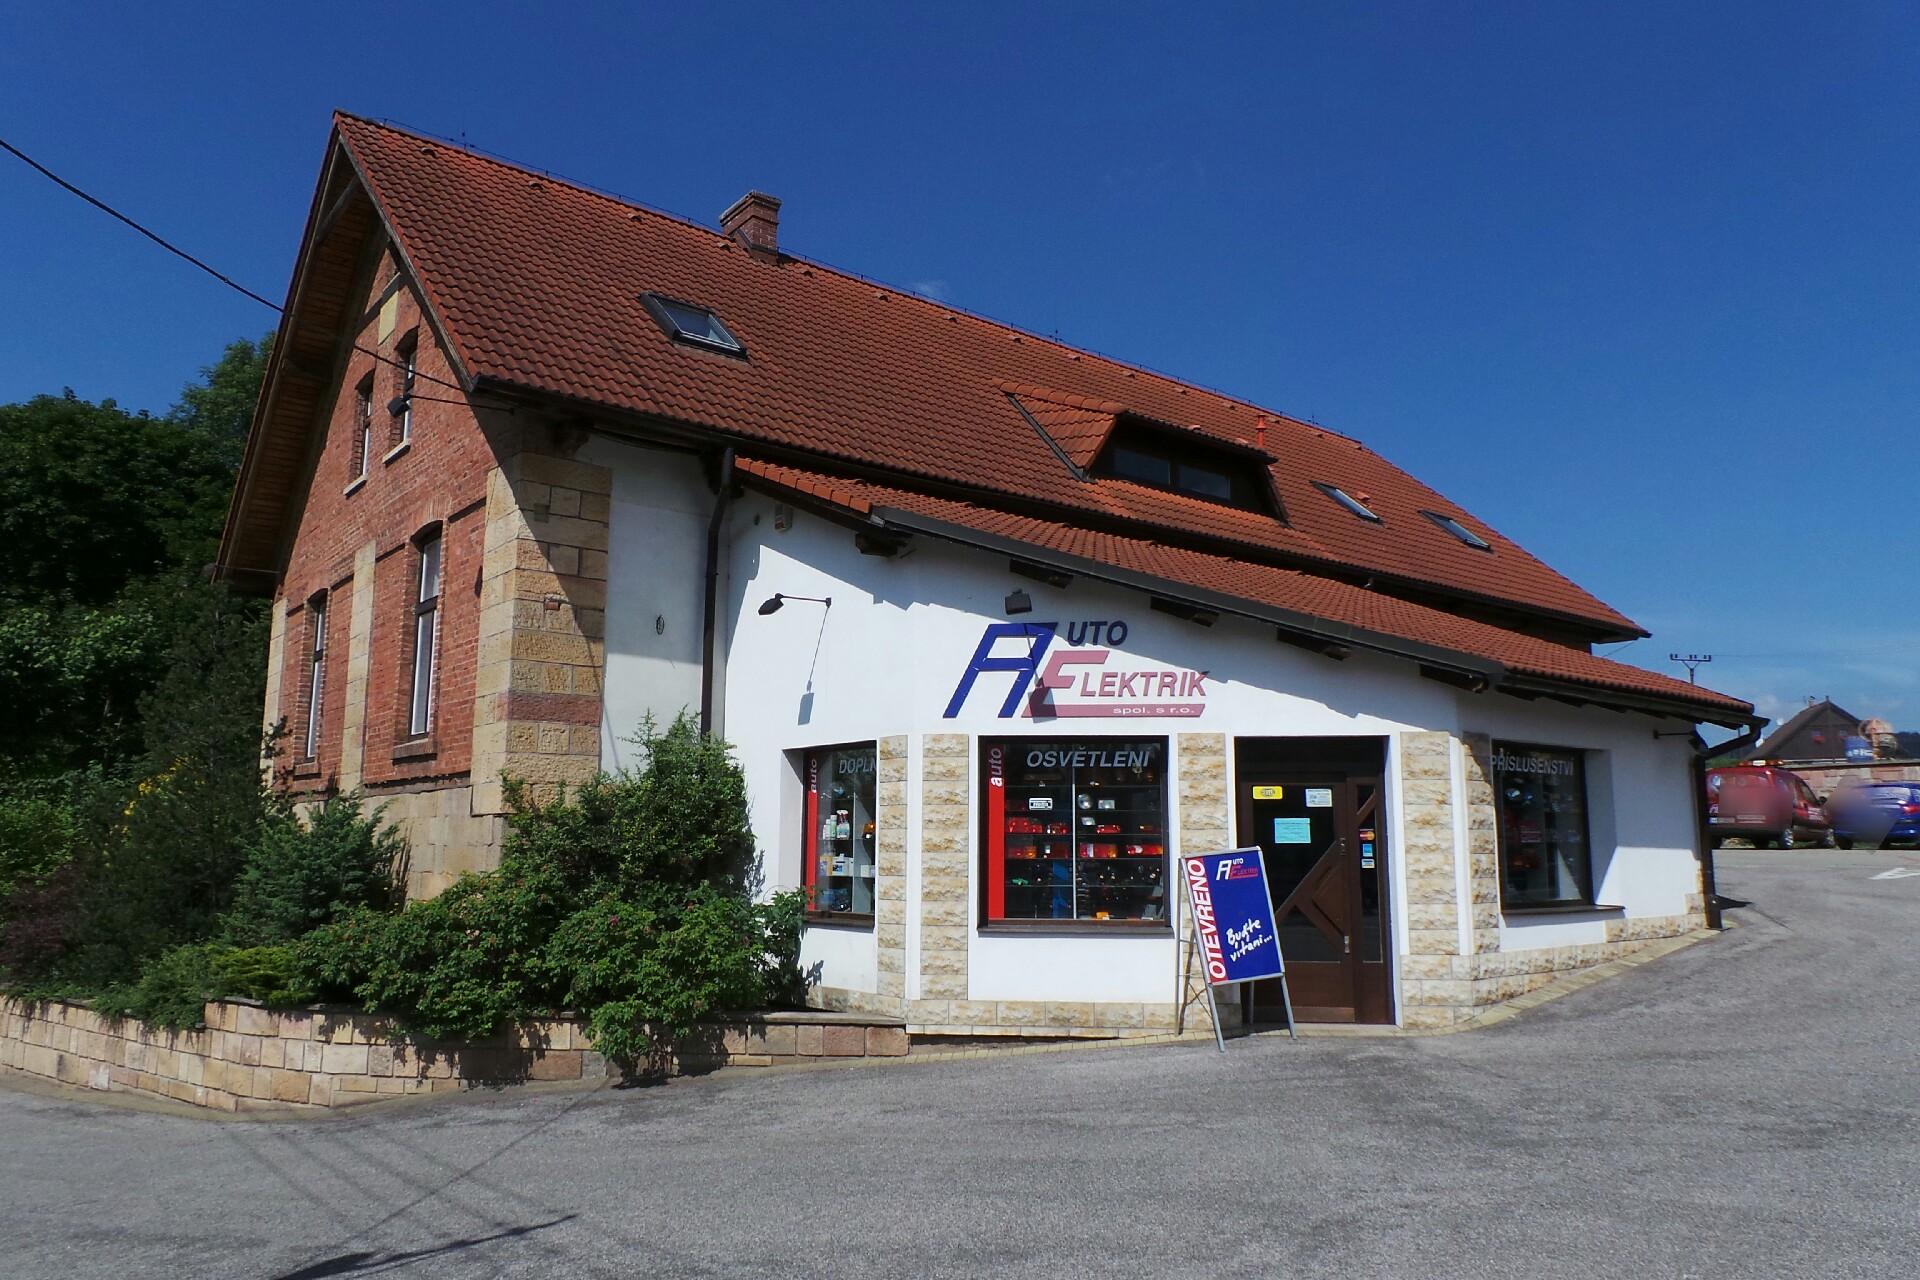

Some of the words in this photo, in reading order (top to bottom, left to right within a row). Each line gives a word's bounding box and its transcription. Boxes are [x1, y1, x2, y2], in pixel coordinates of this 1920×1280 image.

[1021, 650, 1208, 718] ELEKTRIK
[1113, 706, 1150, 715] spol.
[989, 748, 1003, 787] auto
